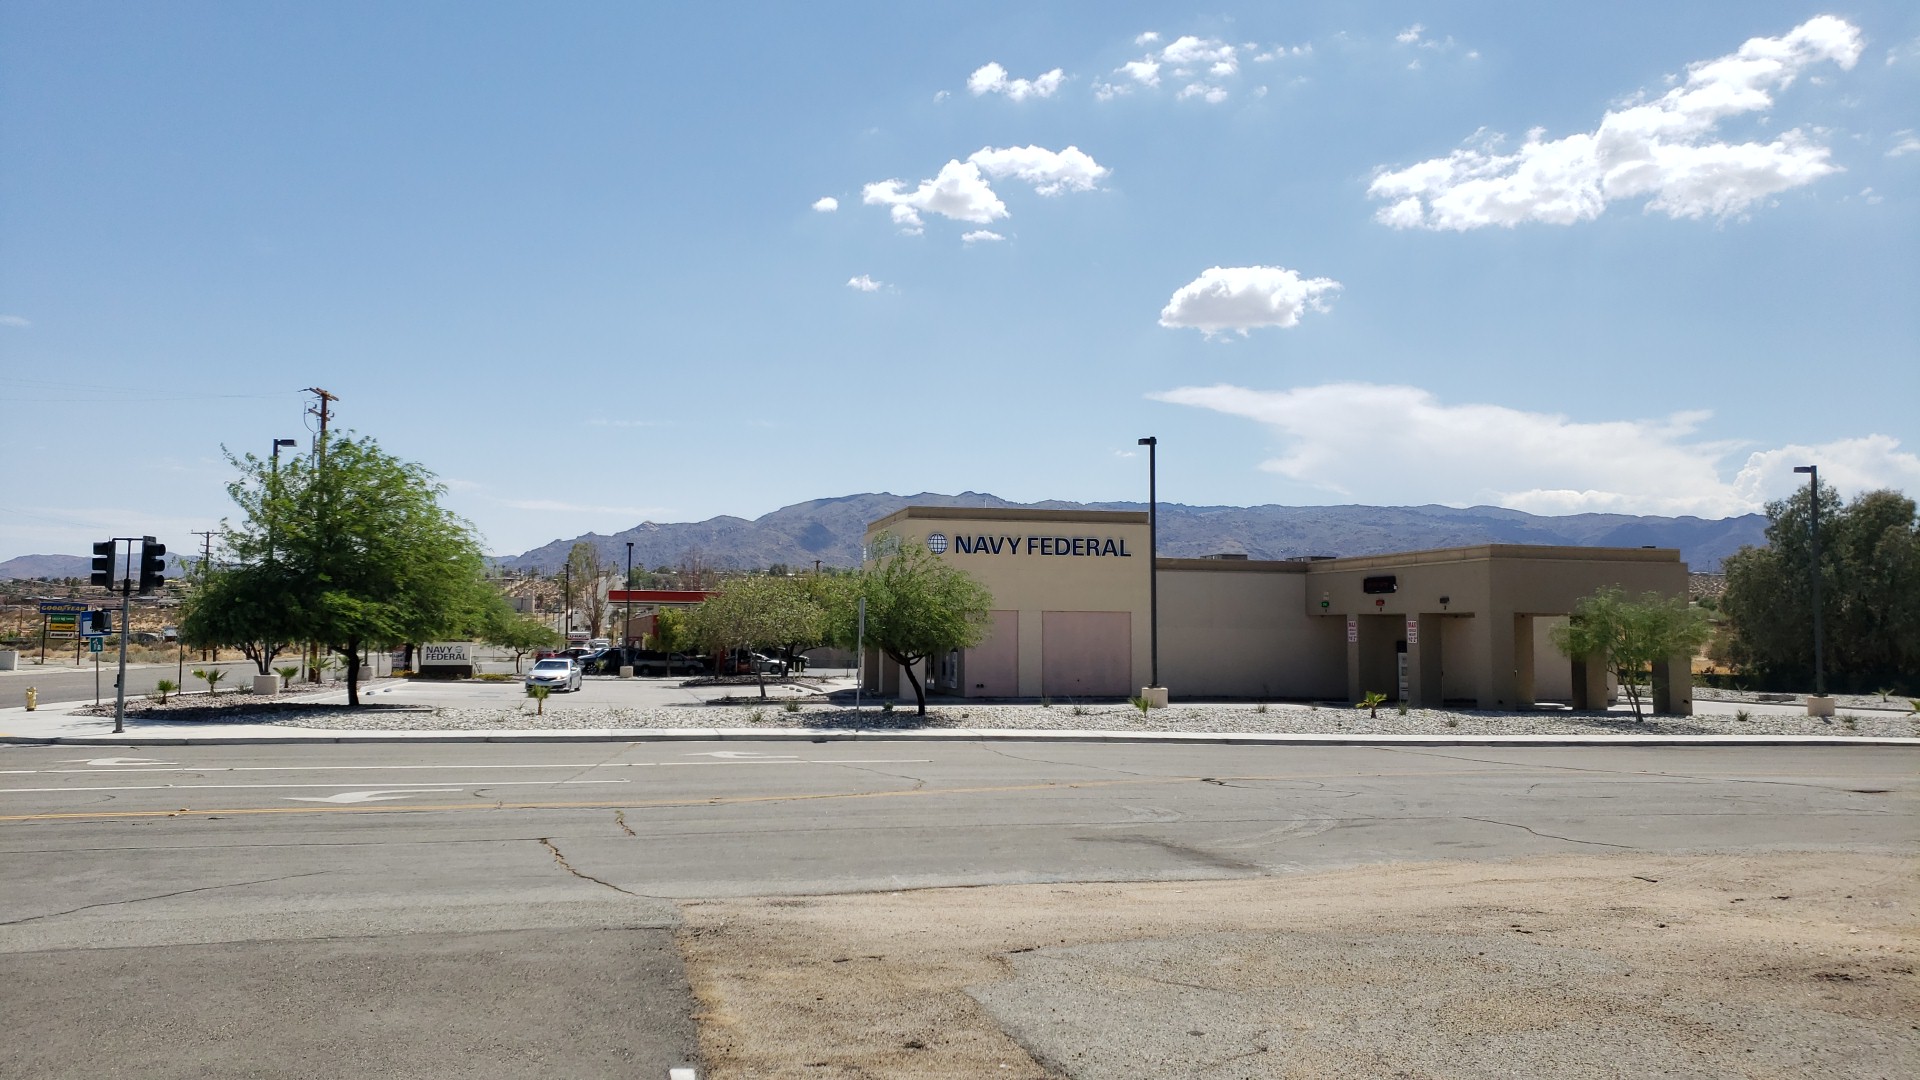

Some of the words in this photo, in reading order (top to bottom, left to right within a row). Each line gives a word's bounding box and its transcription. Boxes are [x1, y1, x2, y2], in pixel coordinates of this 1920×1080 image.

[955, 536, 1022, 555] NAVY
[1027, 537, 1132, 557] FEDERAL
[426, 653, 467, 661] FEDERAL
